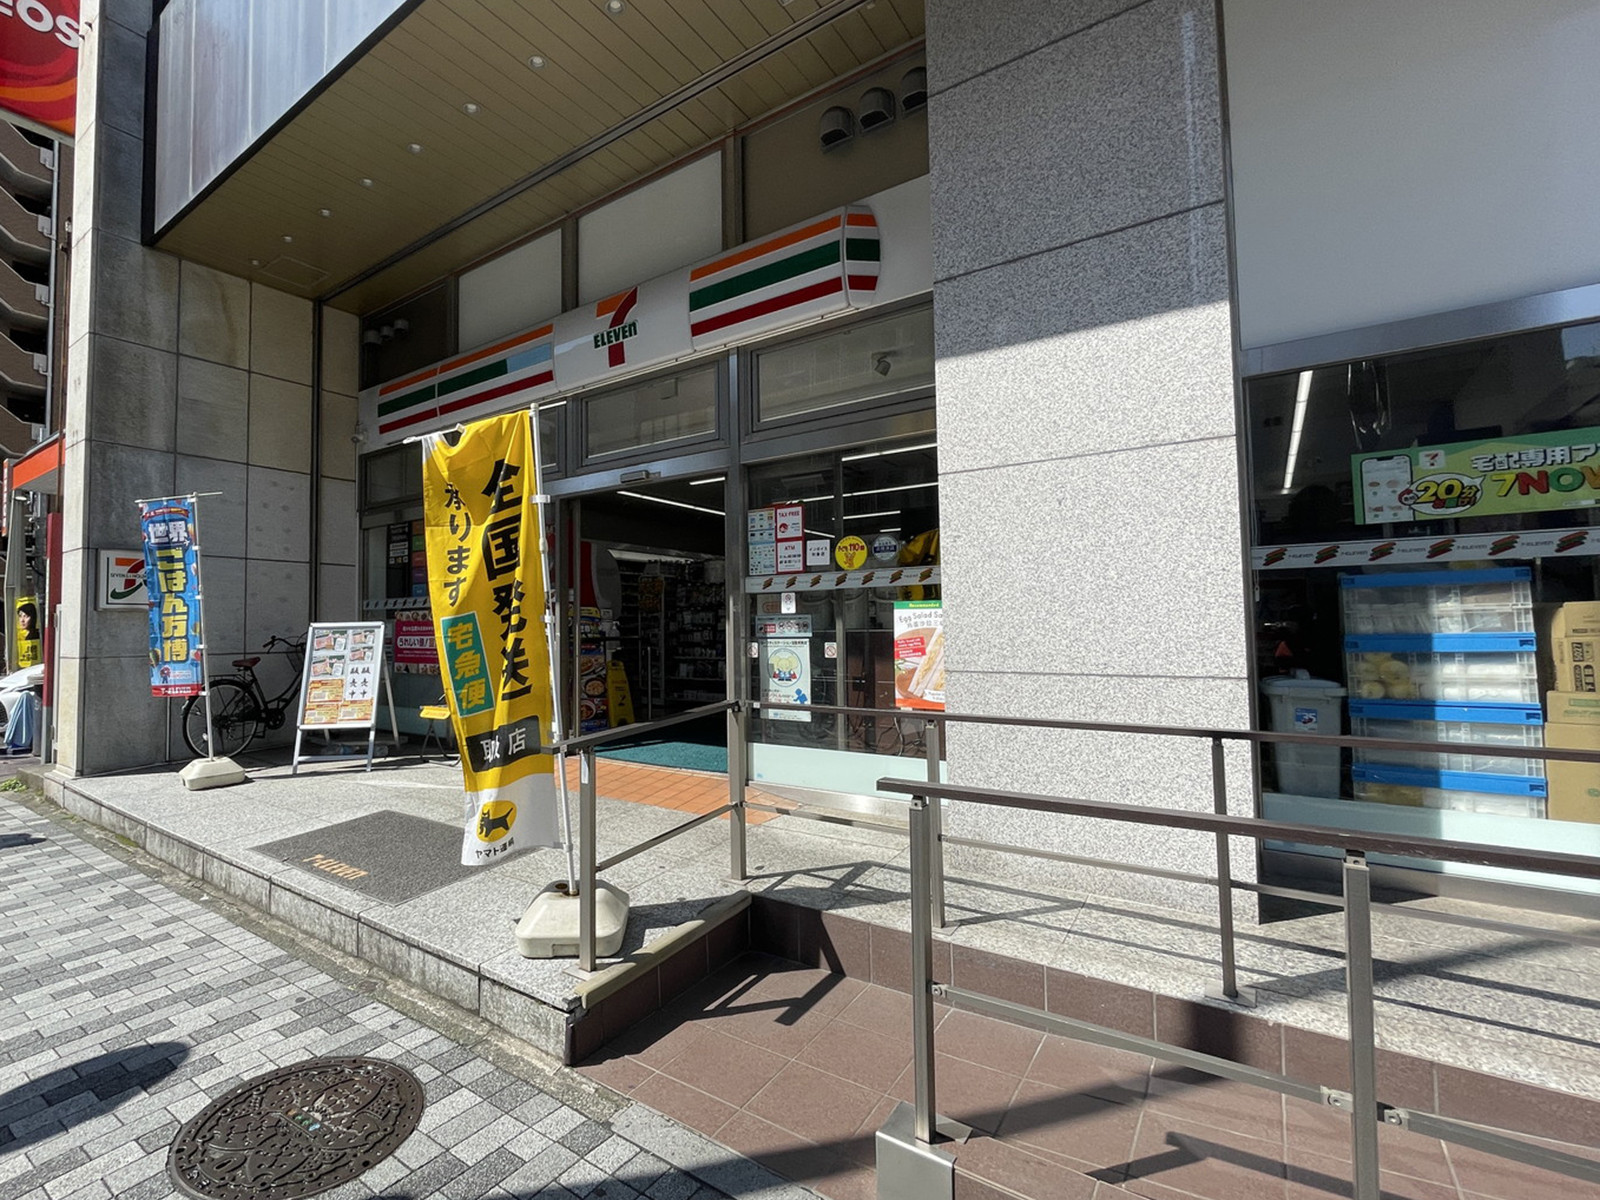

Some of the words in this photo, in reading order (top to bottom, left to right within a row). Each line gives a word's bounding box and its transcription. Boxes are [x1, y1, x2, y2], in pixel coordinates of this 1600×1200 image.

[1472, 443, 1600, 472] 宅配専用ア
[148, 520, 186, 545] 世界
[156, 546, 188, 662] ごはん万博
[898, 615, 912, 623] Egg
[912, 611, 932, 620] Salad
[447, 621, 486, 710] 宅急便
